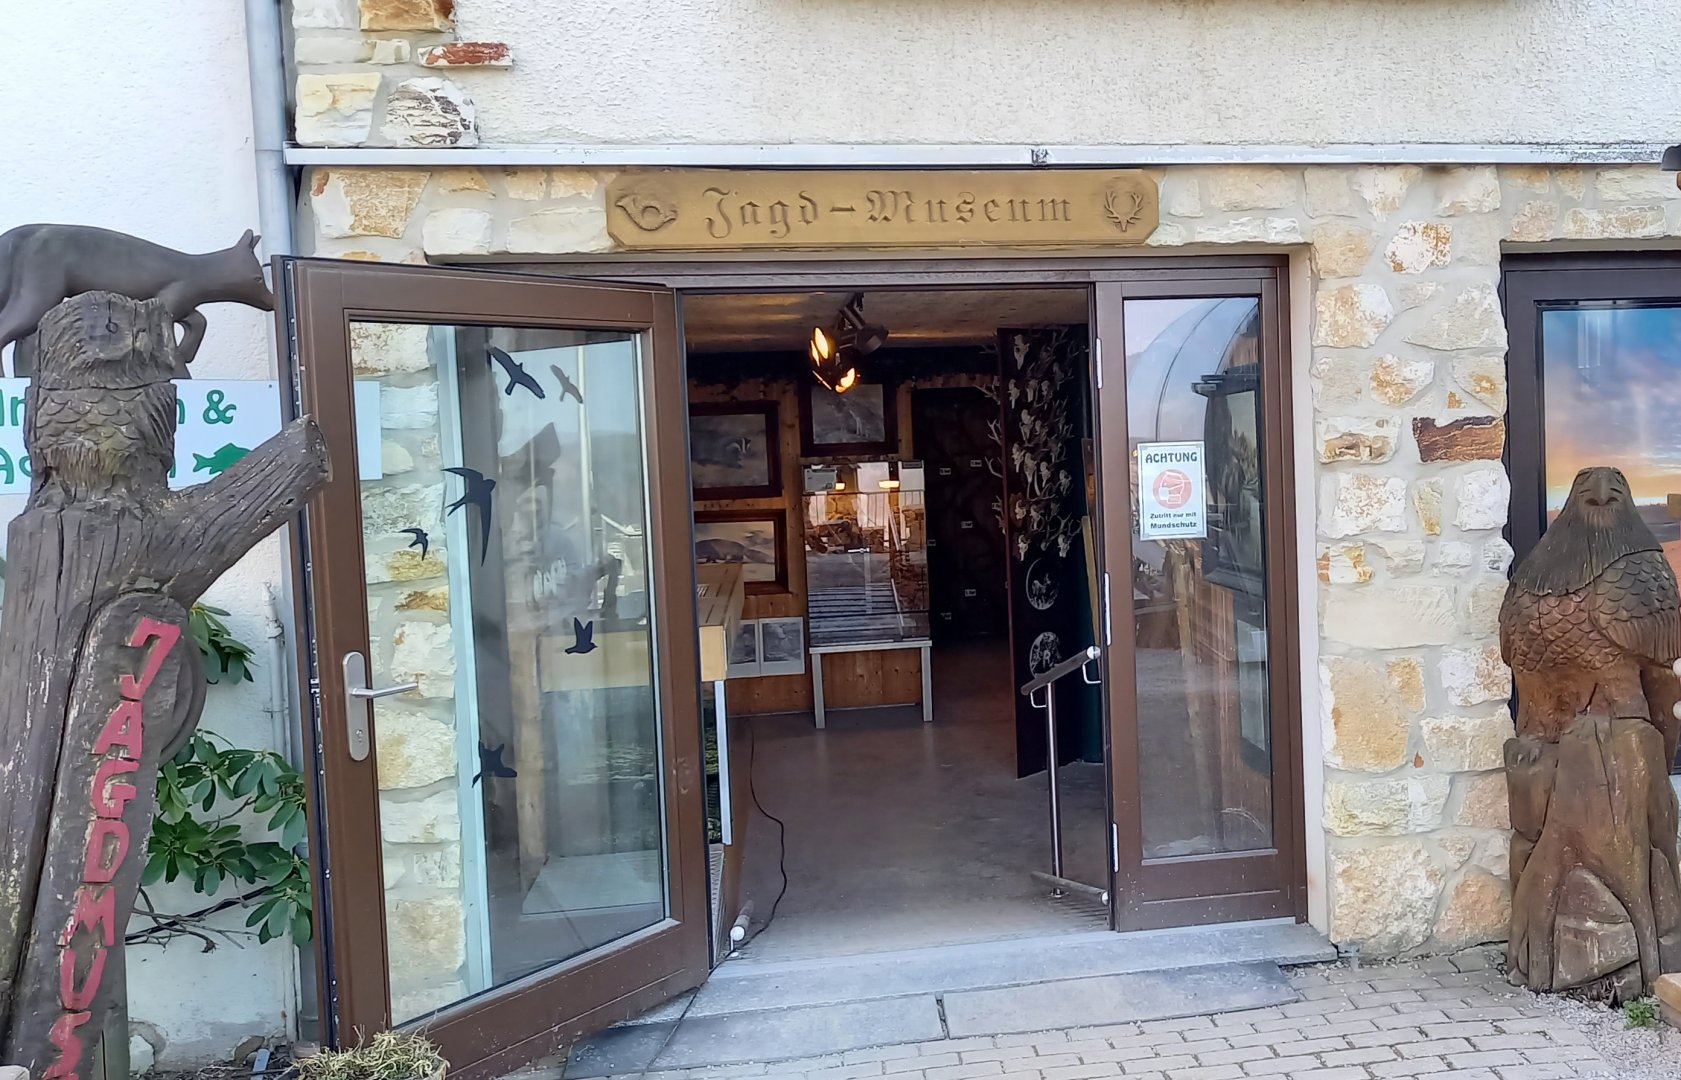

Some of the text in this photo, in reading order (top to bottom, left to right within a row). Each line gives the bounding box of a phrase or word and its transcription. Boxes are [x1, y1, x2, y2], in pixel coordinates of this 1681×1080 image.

[1145, 452, 1198, 463] ACHTUNG
[1150, 521, 1197, 529] Mundschutz
[42, 616, 181, 1080] JAGDMUS
